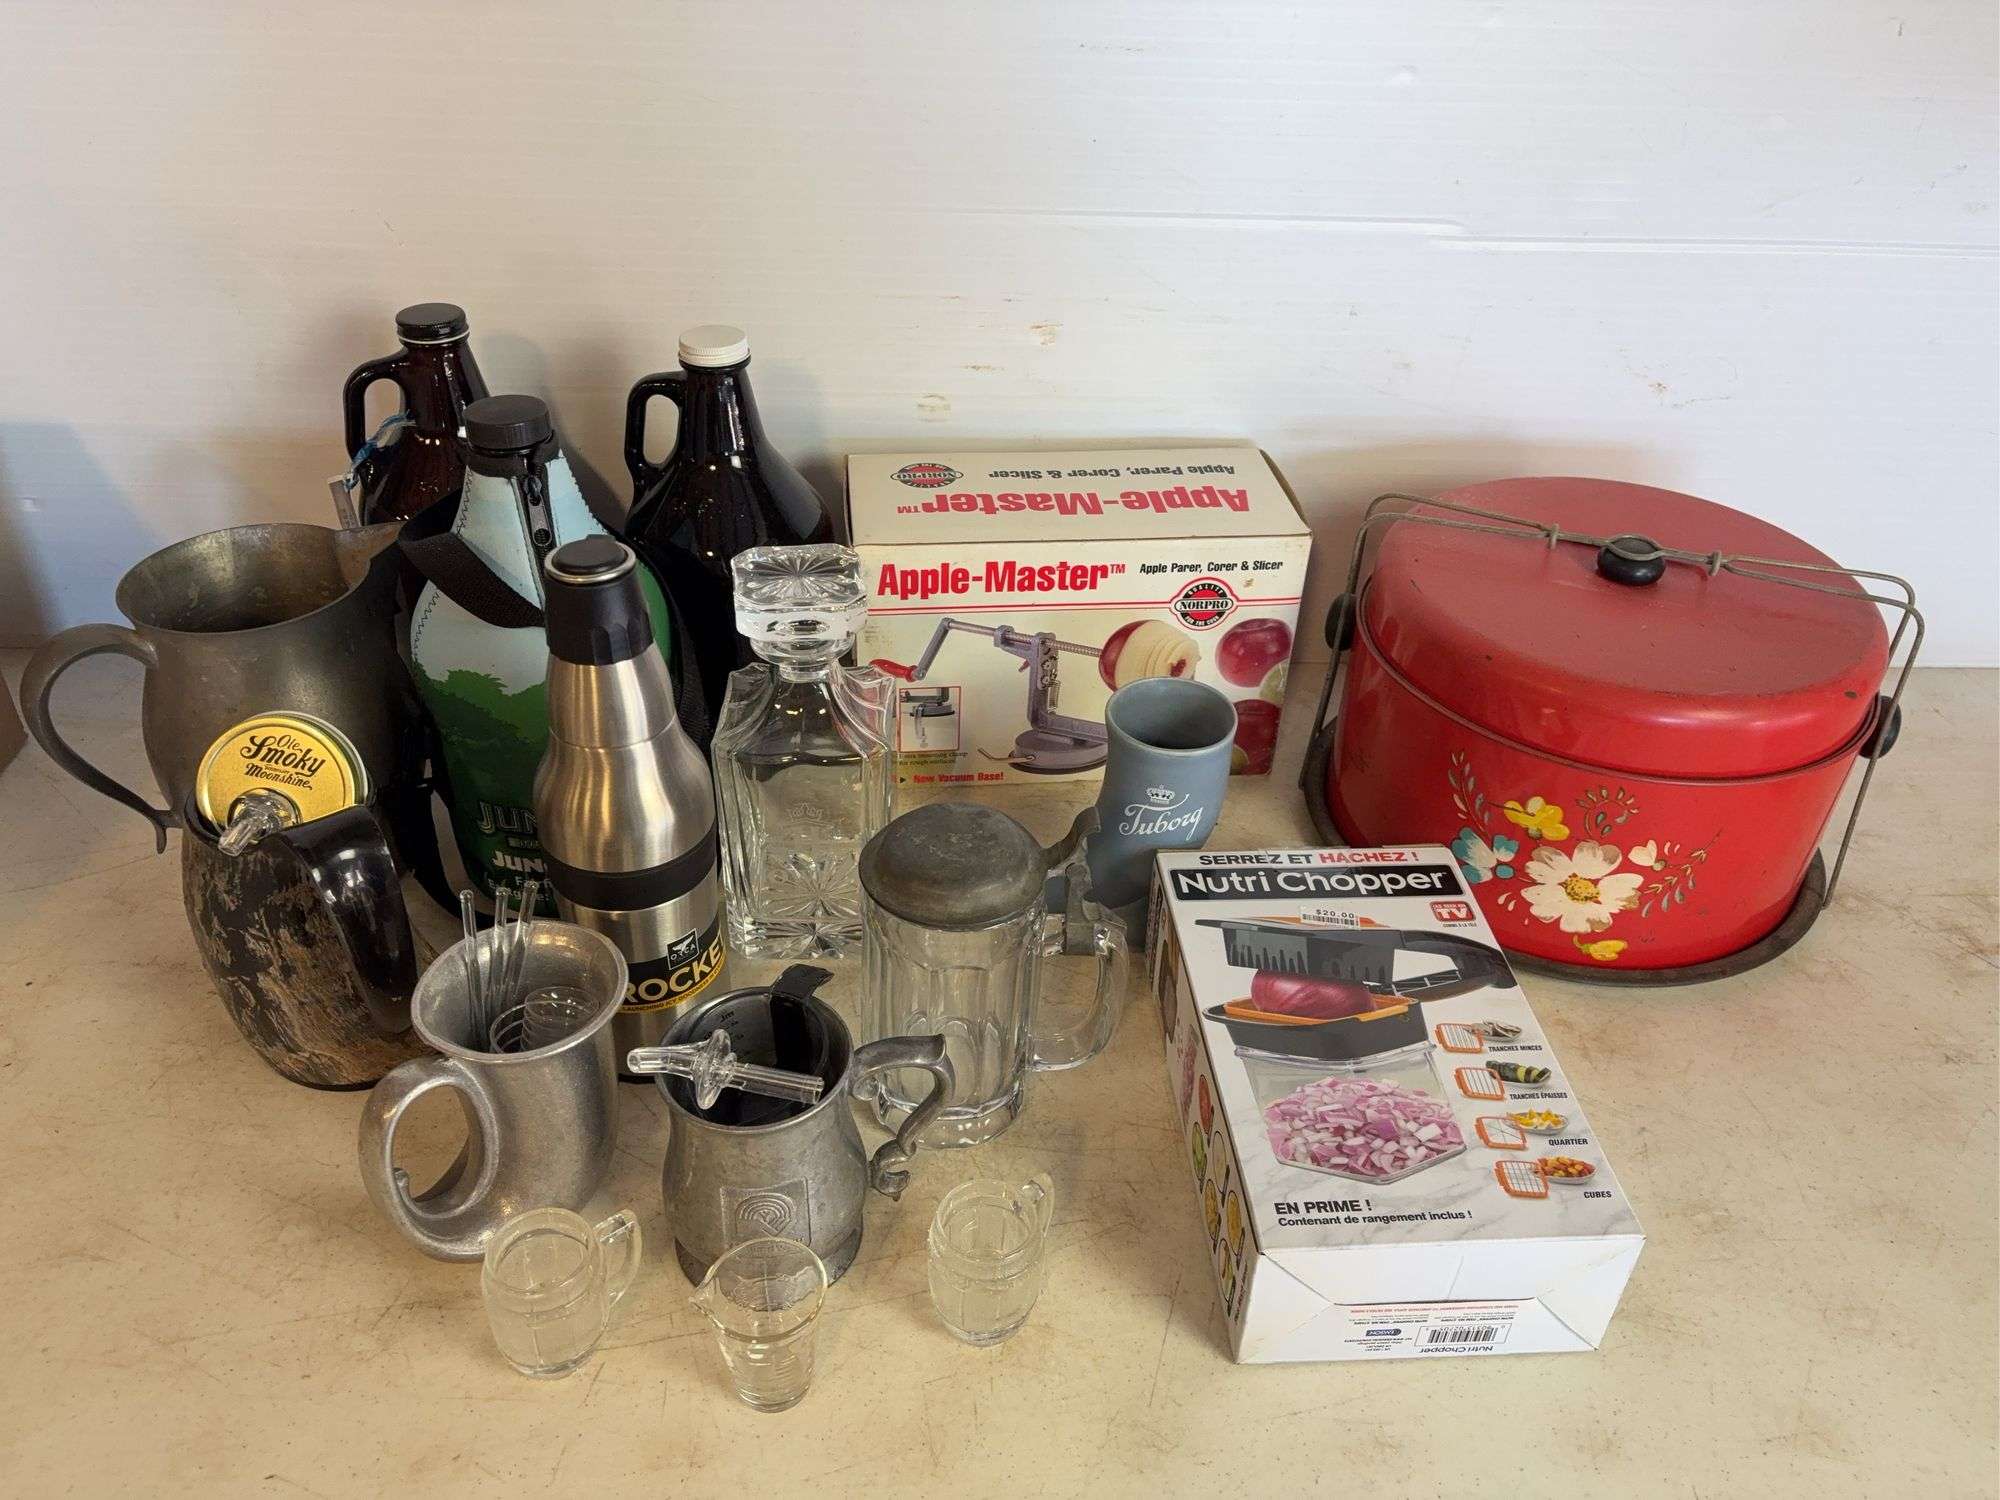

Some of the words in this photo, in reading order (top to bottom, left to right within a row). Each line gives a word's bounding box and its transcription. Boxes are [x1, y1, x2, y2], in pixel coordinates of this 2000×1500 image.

[989, 470, 1043, 479] Slicer
[1047, 470, 1062, 479] &
[1067, 468, 1121, 478] Corer
[1126, 466, 1184, 476] Parer,
[1188, 465, 1235, 475] Apple
[1140, 563, 1167, 575] Apple
[1171, 562, 1203, 573] Parer,
[1207, 561, 1237, 572] Corer
[1241, 560, 1249, 571] &
[1253, 560, 1283, 571] Slicer
[1180, 600, 1229, 610] NORPRO
[277, 734, 303, 753] Ole
[240, 735, 326, 778] Smoky
[244, 762, 313, 791] Moonshine
[913, 774, 935, 784] New
[938, 773, 975, 783] Vacuum
[977, 772, 1004, 781] Base!
[1119, 793, 1204, 841] Tuborg
[1199, 853, 1283, 866] SERREZ
[1288, 853, 1313, 865] ET
[1319, 851, 1408, 864] HACHEZ
[1177, 870, 1272, 894] Nutri
[1315, 908, 1355, 919] $20.00
[1435, 908, 1468, 919] TV
[670, 943, 696, 961] ORCA
[625, 932, 723, 1003] ROCKE
[1488, 1045, 1519, 1053] TRANCHES
[1548, 1138, 1588, 1146] QUARTIER
[1583, 1190, 1612, 1199] CUBES
[1274, 1202, 1300, 1215] EN
[1304, 1200, 1362, 1214] PRIME
[1278, 1214, 1342, 1227] Contenant
[1344, 1215, 1360, 1225] de
[1362, 1212, 1427, 1225] rangement
[1429, 1210, 1467, 1221] inclus
[1419, 1346, 1466, 1354] Chopper
